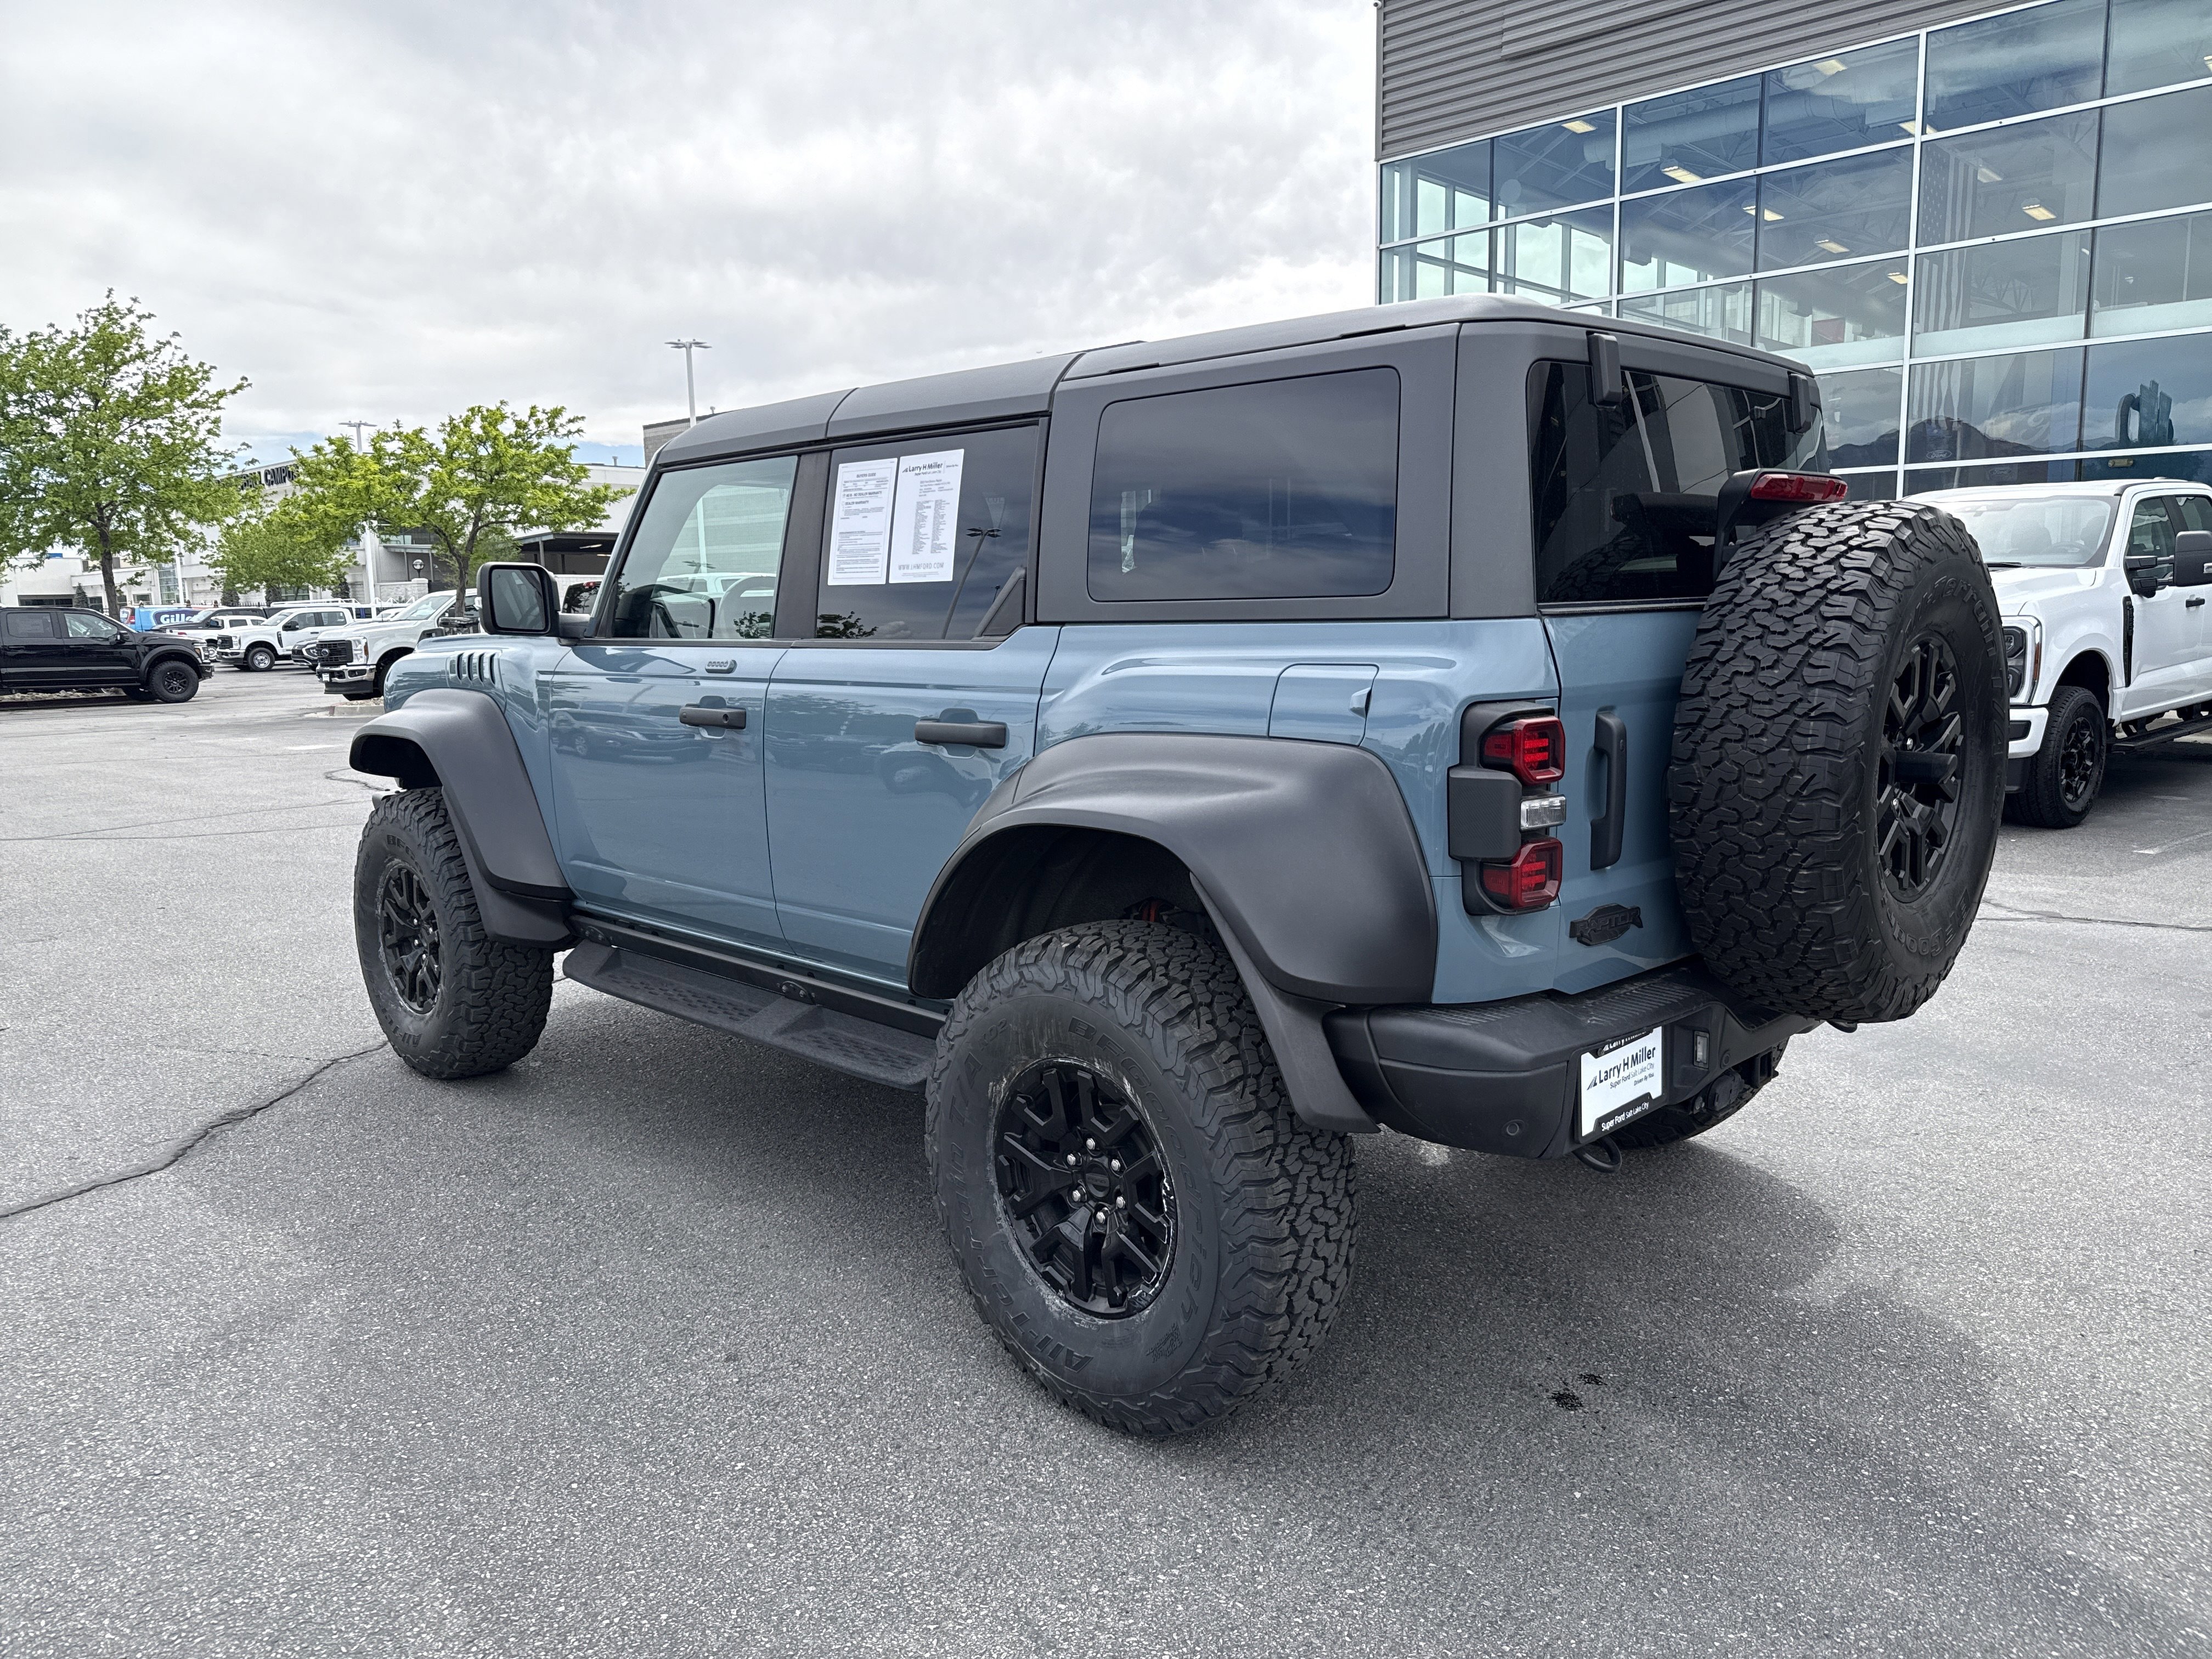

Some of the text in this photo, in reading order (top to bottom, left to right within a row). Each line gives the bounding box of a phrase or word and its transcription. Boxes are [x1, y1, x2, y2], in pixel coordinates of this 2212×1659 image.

[1576, 907, 1643, 940] RAPTOR
[1599, 1046, 1656, 1084] Larry H Miller
[1610, 1078, 1621, 1089] Super
[1622, 1073, 1630, 1083] Ford
[1638, 1066, 1646, 1075] Lake
[1601, 1119, 1615, 1131] Super
[1615, 1111, 1625, 1125] Ford
[1633, 1105, 1641, 1116] Lake
[1641, 1102, 1650, 1110] City
[1068, 1016, 1207, 1325] BFGoodrich
[950, 1141, 1094, 1373] All-Terrain
